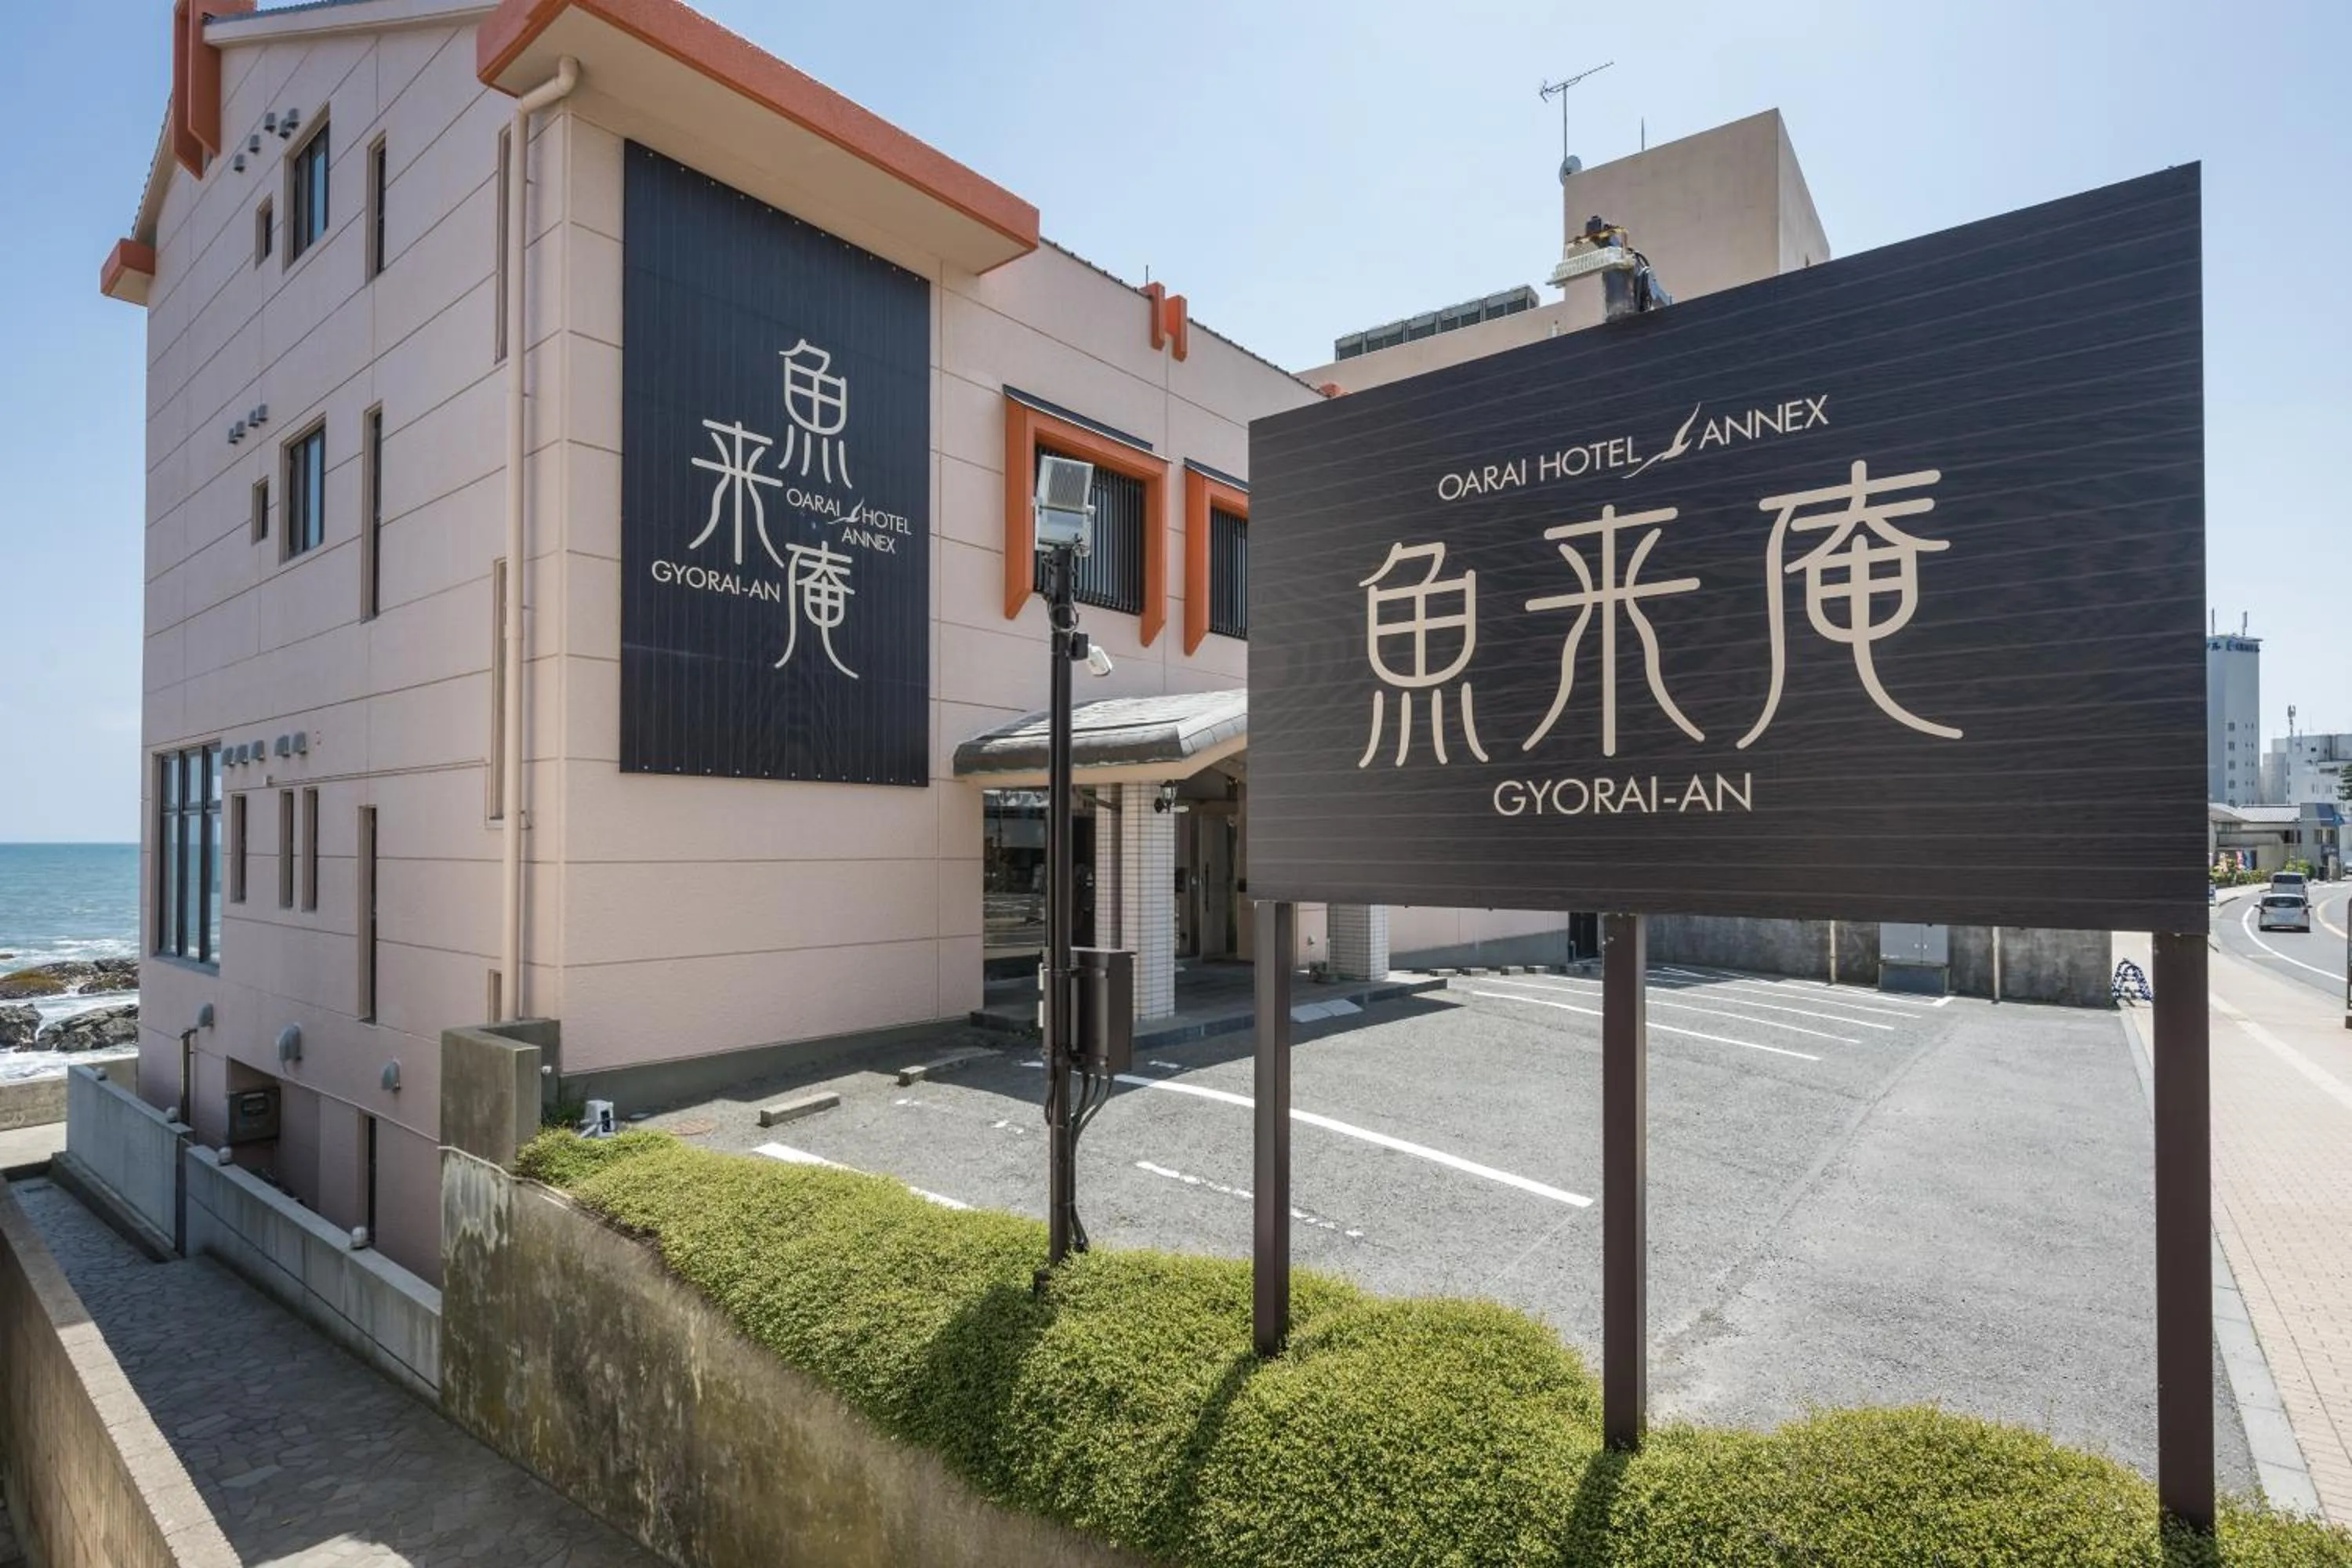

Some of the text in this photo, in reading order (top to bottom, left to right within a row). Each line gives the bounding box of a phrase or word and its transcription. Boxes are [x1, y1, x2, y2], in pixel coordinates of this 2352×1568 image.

[1438, 394, 1830, 502] OARAI HOTEL ANNEX
[786, 487, 913, 536] OARAI HOTEL
[840, 528, 897, 555] ANNEX
[651, 559, 782, 604] GYORAI-AN
[1357, 459, 1965, 769] 魚来庵
[1493, 771, 1753, 817] GYORAI-AN
